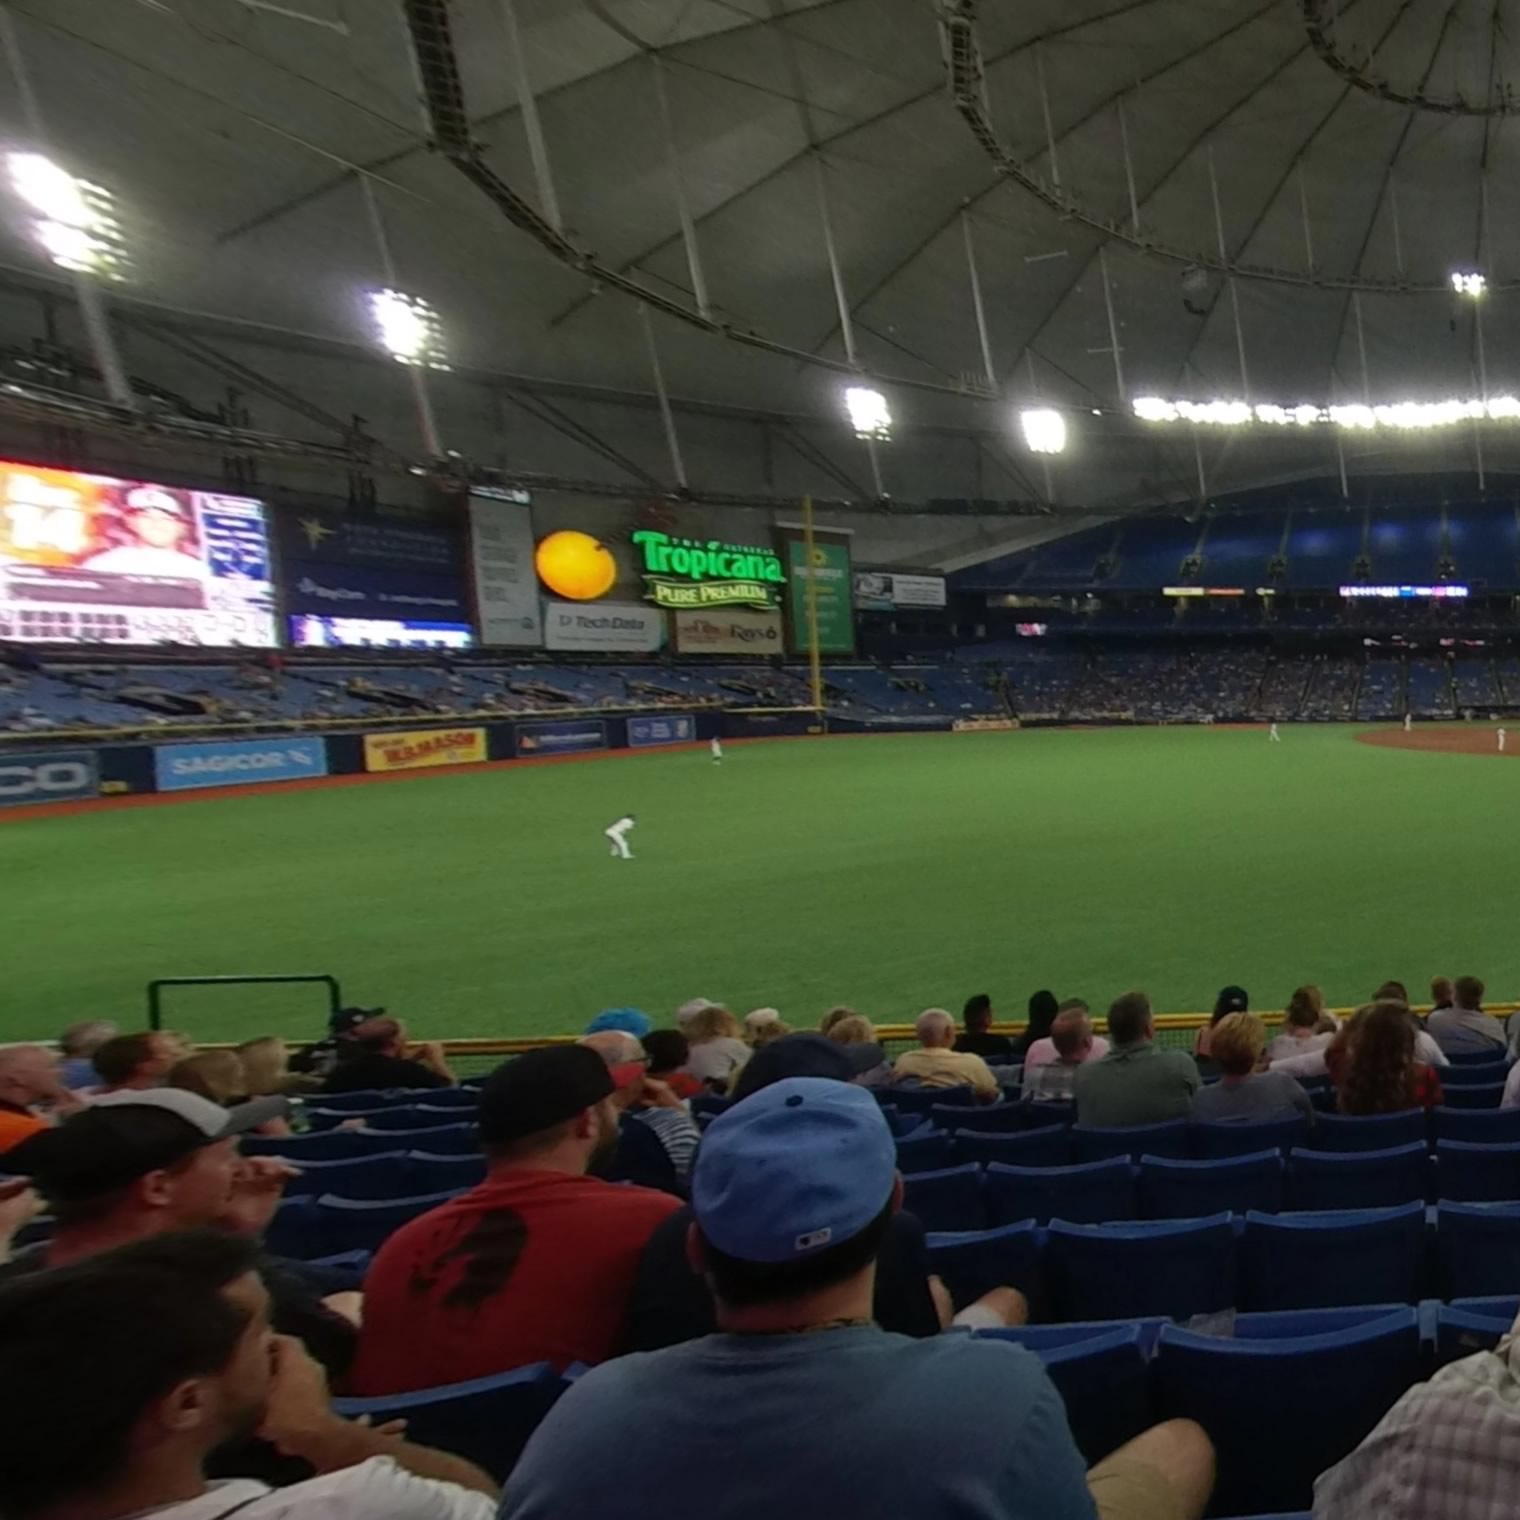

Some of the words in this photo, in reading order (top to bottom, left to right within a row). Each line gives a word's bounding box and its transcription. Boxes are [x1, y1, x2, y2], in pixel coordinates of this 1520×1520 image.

[633, 530, 782, 581] Tropicana
[656, 585, 698, 602] PURE
[700, 585, 767, 602] PREMIUM
[172, 751, 285, 775] SAGICOR
